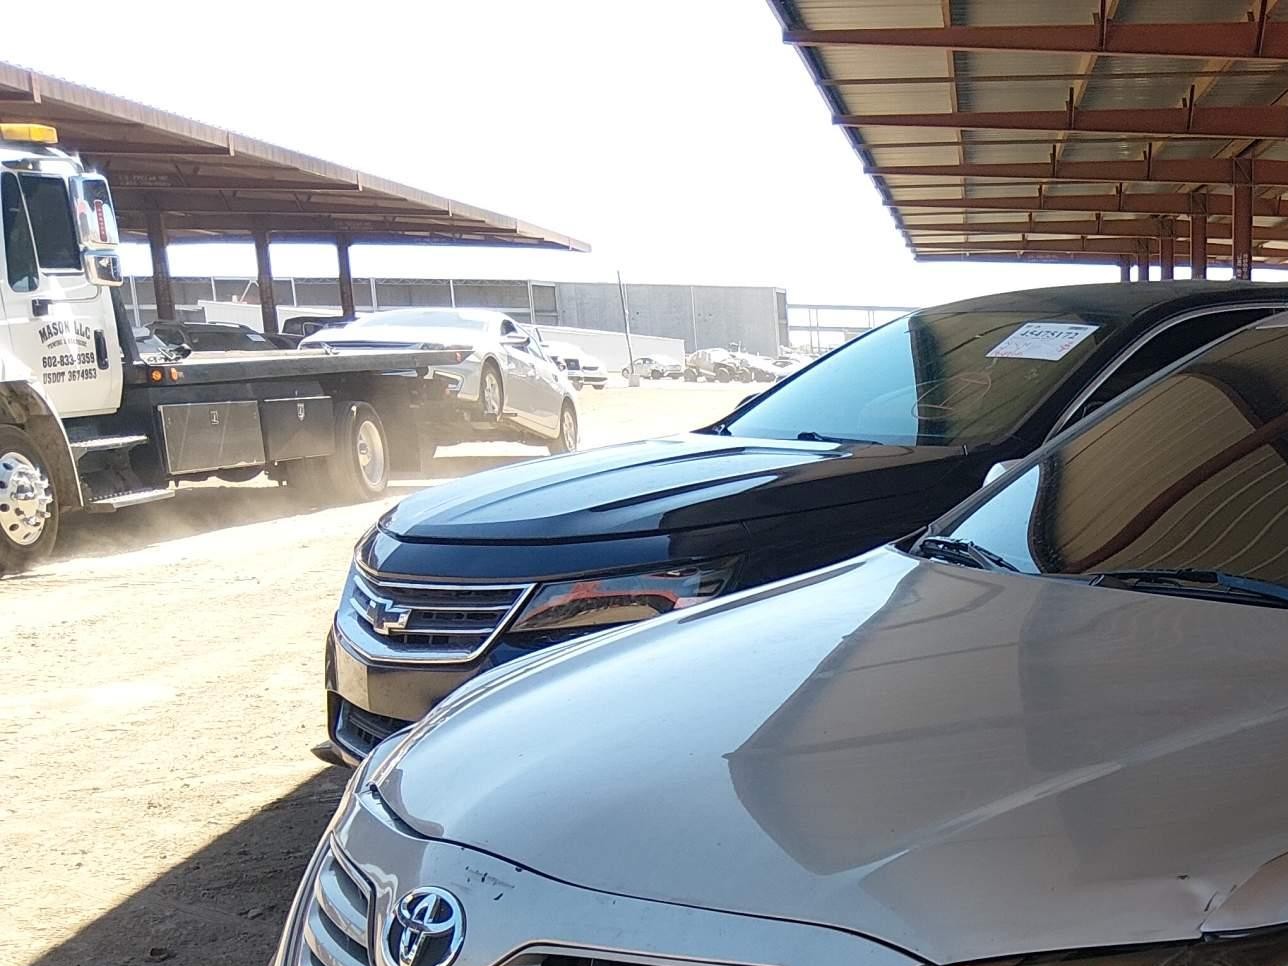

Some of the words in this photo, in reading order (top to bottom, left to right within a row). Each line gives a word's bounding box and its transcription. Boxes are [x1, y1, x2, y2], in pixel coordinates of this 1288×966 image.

[39, 320, 70, 344] MASON
[74, 320, 90, 340] LLC
[42, 352, 95, 368] 602-833-9359
[43, 372, 65, 384] USDOT
[68, 368, 97, 381] 3674953
